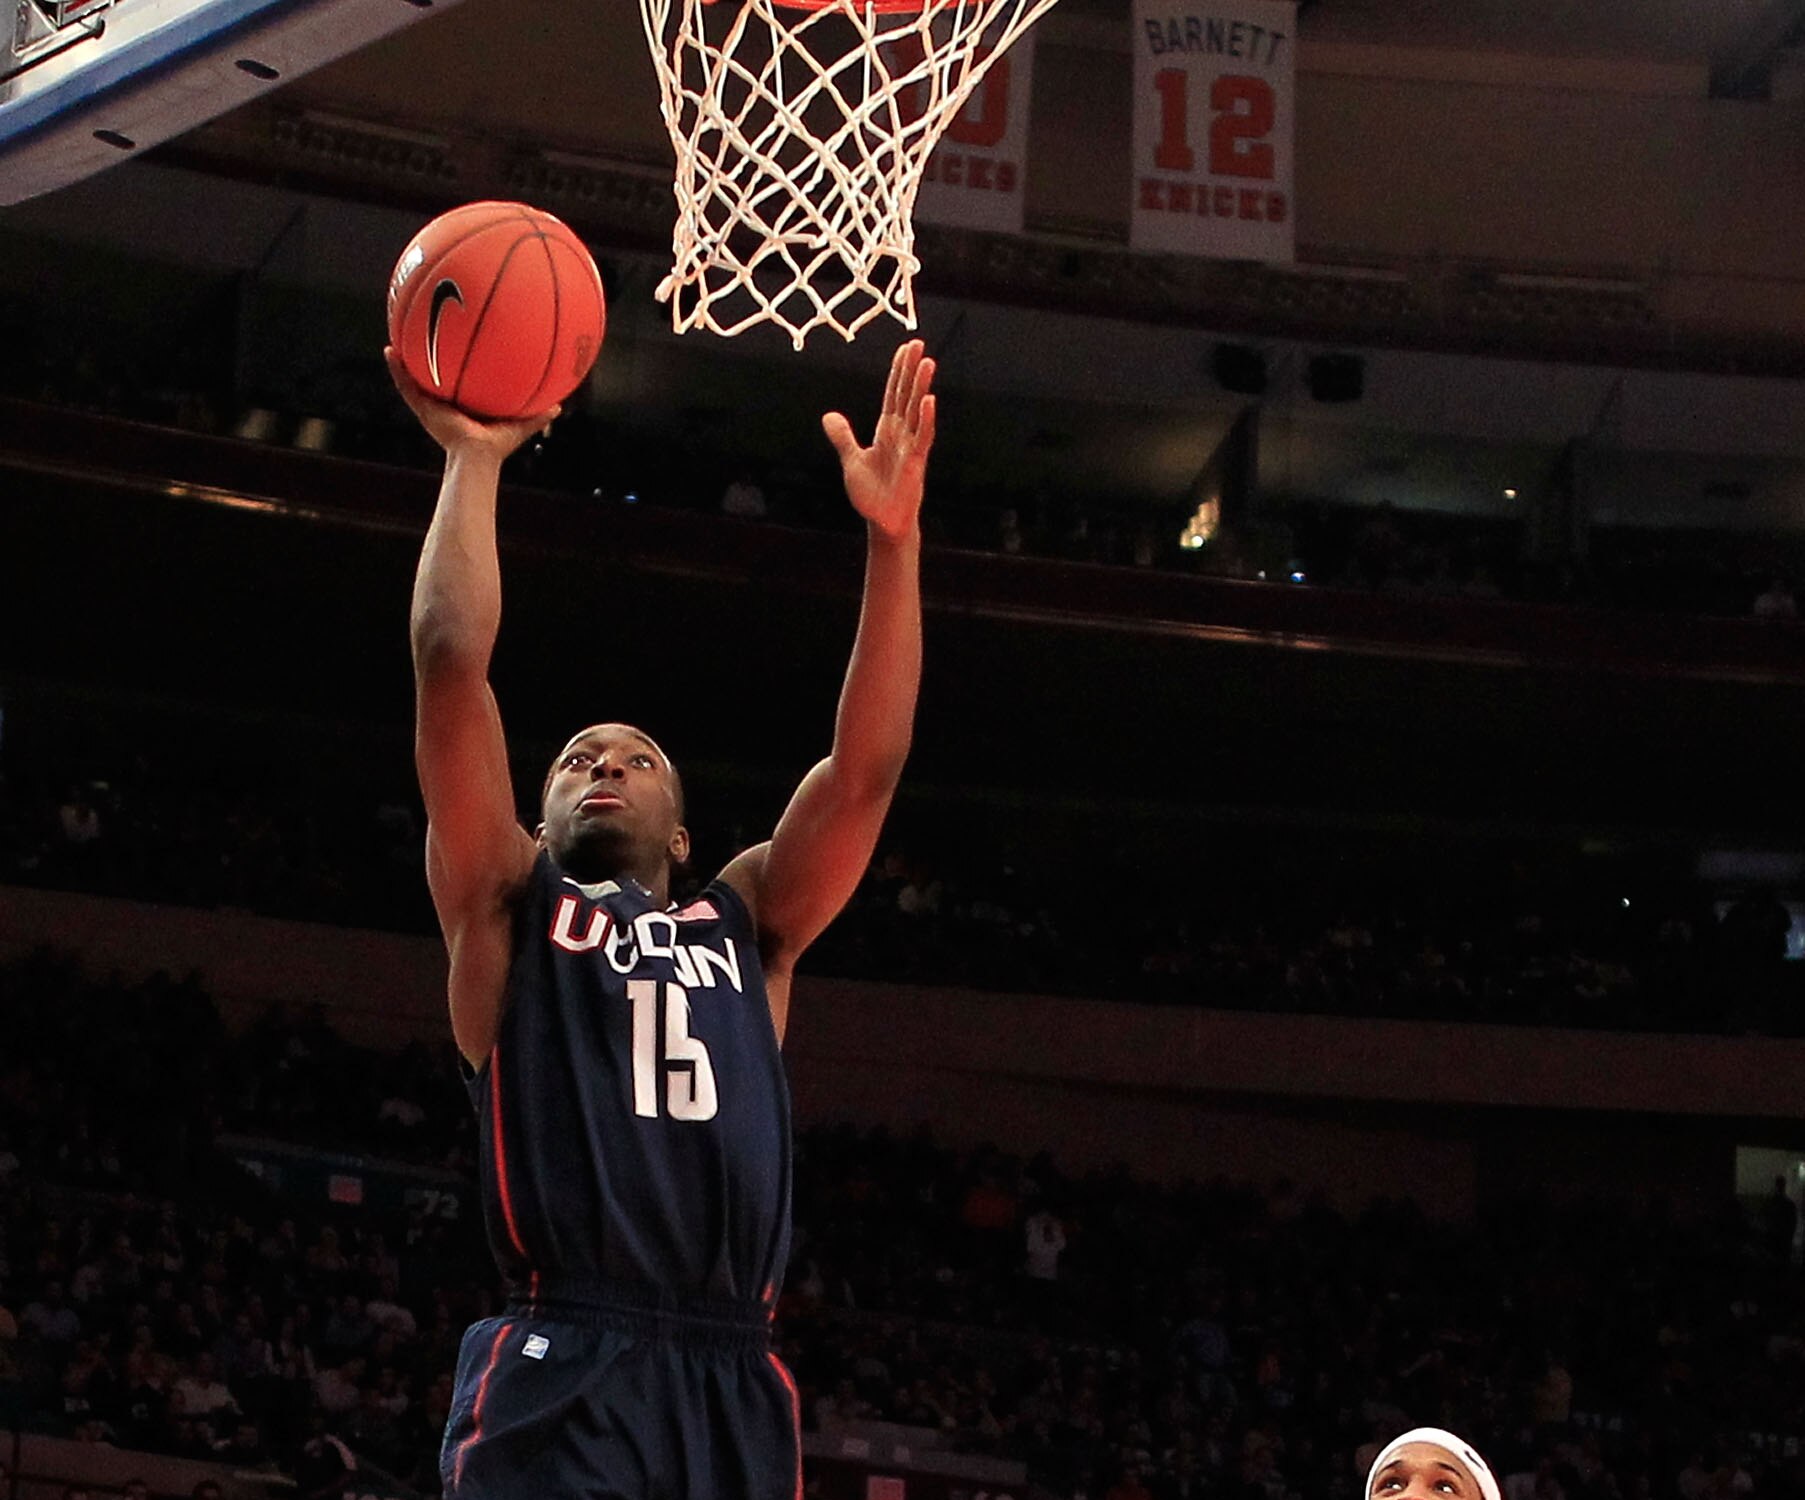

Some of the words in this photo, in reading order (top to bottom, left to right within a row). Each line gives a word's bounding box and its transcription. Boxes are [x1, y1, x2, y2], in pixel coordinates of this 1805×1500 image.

[1145, 16, 1286, 64] BARNETT
[1154, 67, 1277, 178] 12
[1139, 178, 1287, 223] KNICKS
[548, 893, 744, 994] UCONN
[625, 979, 720, 1122] 15
